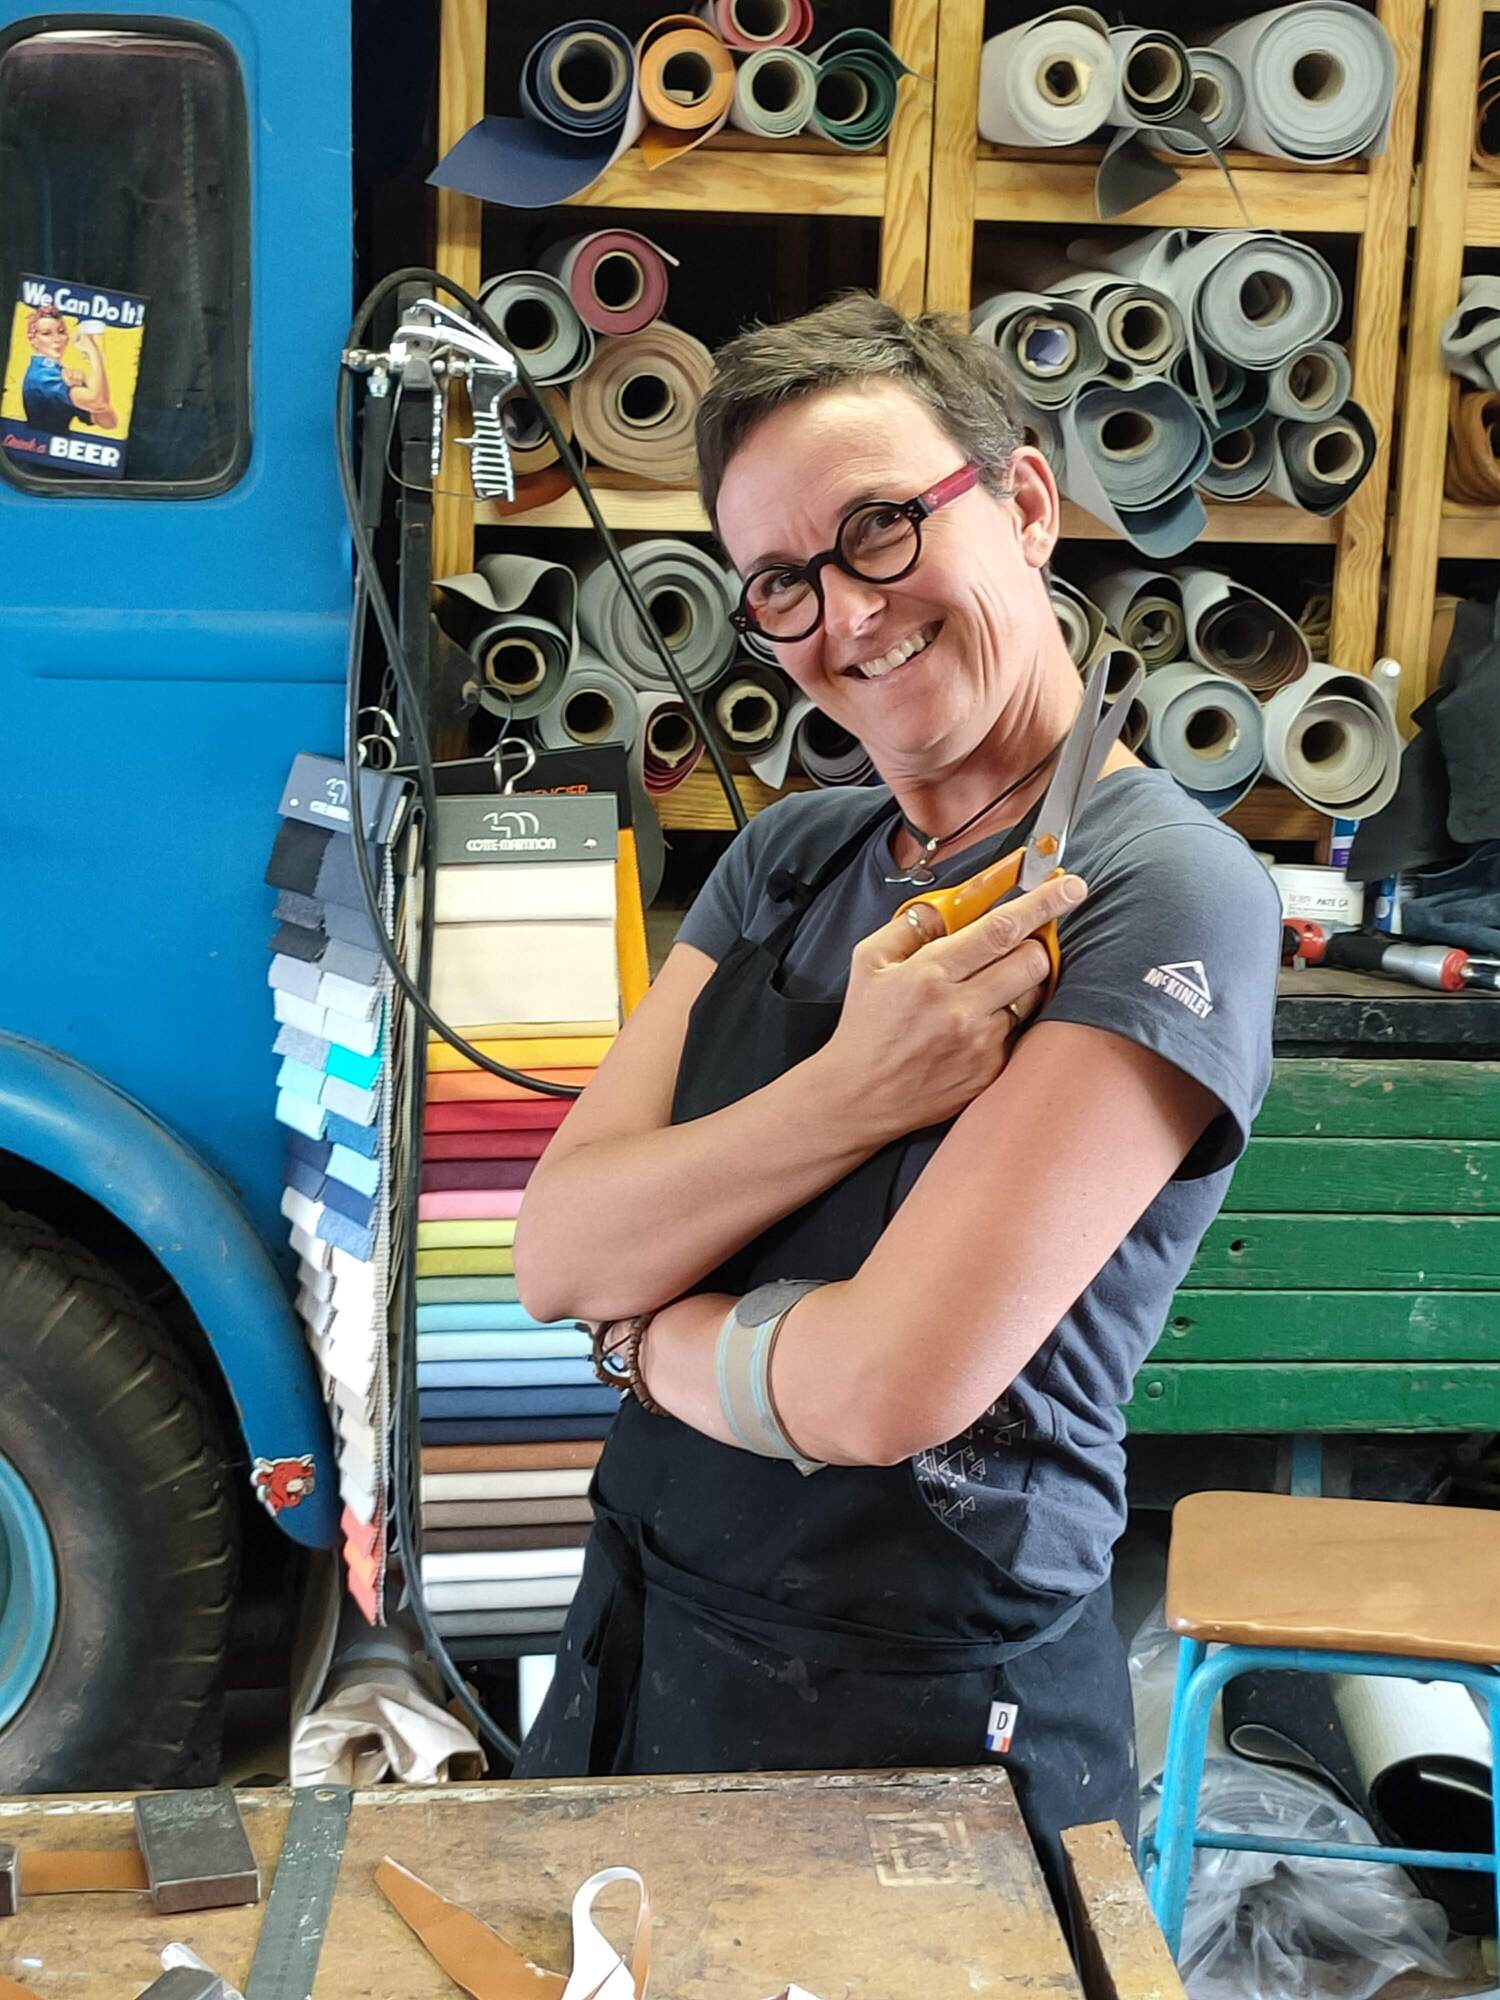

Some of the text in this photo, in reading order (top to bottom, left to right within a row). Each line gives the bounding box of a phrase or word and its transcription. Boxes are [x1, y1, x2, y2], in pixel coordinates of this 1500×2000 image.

[22, 281, 145, 326] We Can Do It!
[49, 435, 120, 468] BEER
[996, 1711, 1008, 1731] D
